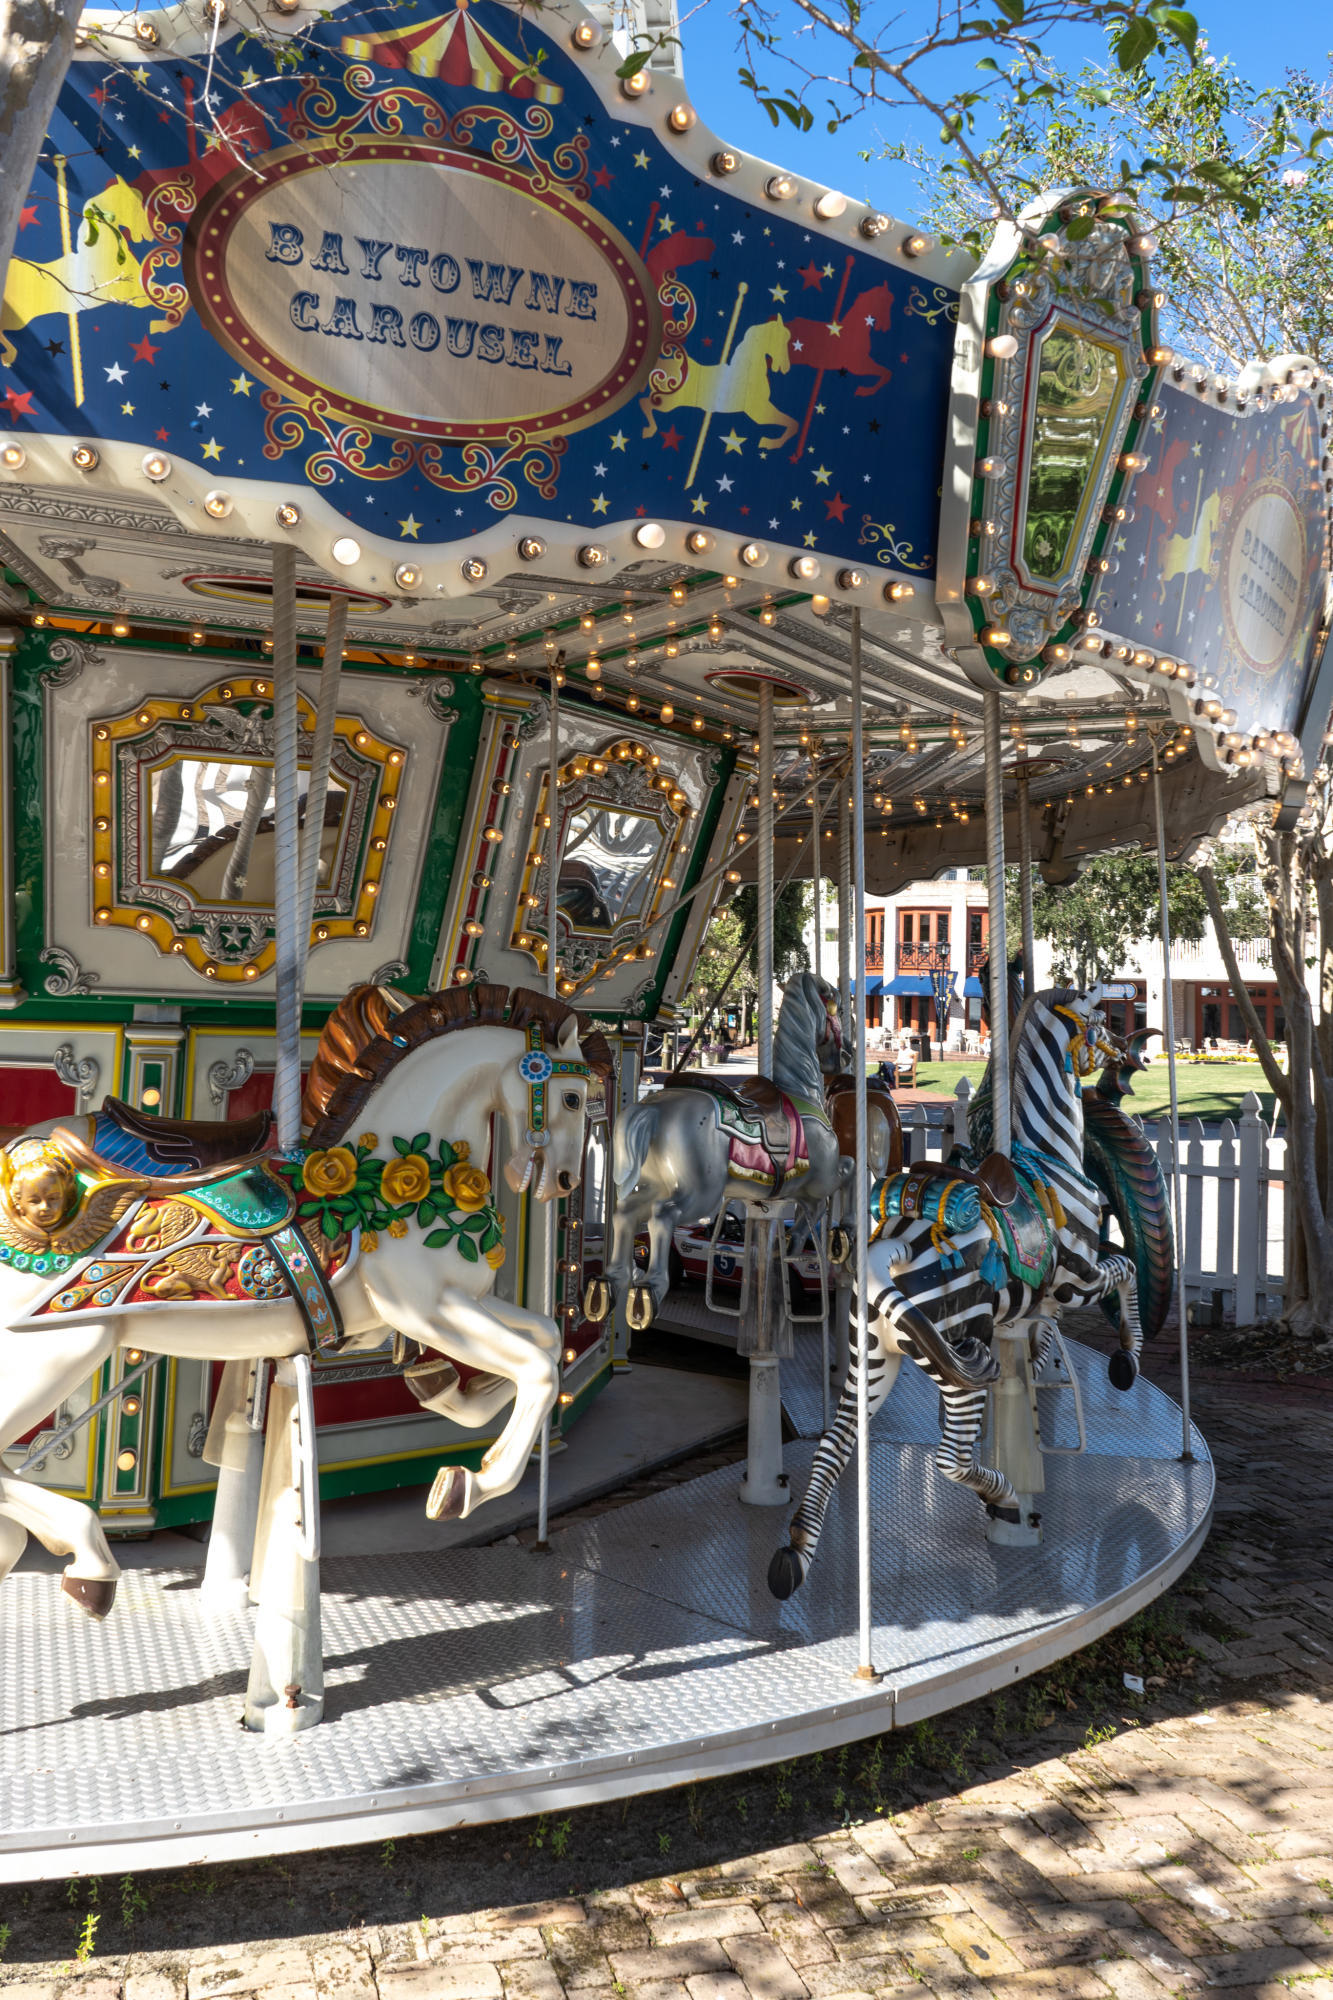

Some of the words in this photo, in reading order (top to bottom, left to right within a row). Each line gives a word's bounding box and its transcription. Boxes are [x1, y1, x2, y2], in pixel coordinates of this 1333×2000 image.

[264, 221, 598, 322] BAYTOWNE
[289, 290, 573, 378] CAROUSEL
[1240, 528, 1298, 604] BAYTOWNE
[1239, 573, 1287, 637] CAROUSEL
[719, 1253, 729, 1270] 5
